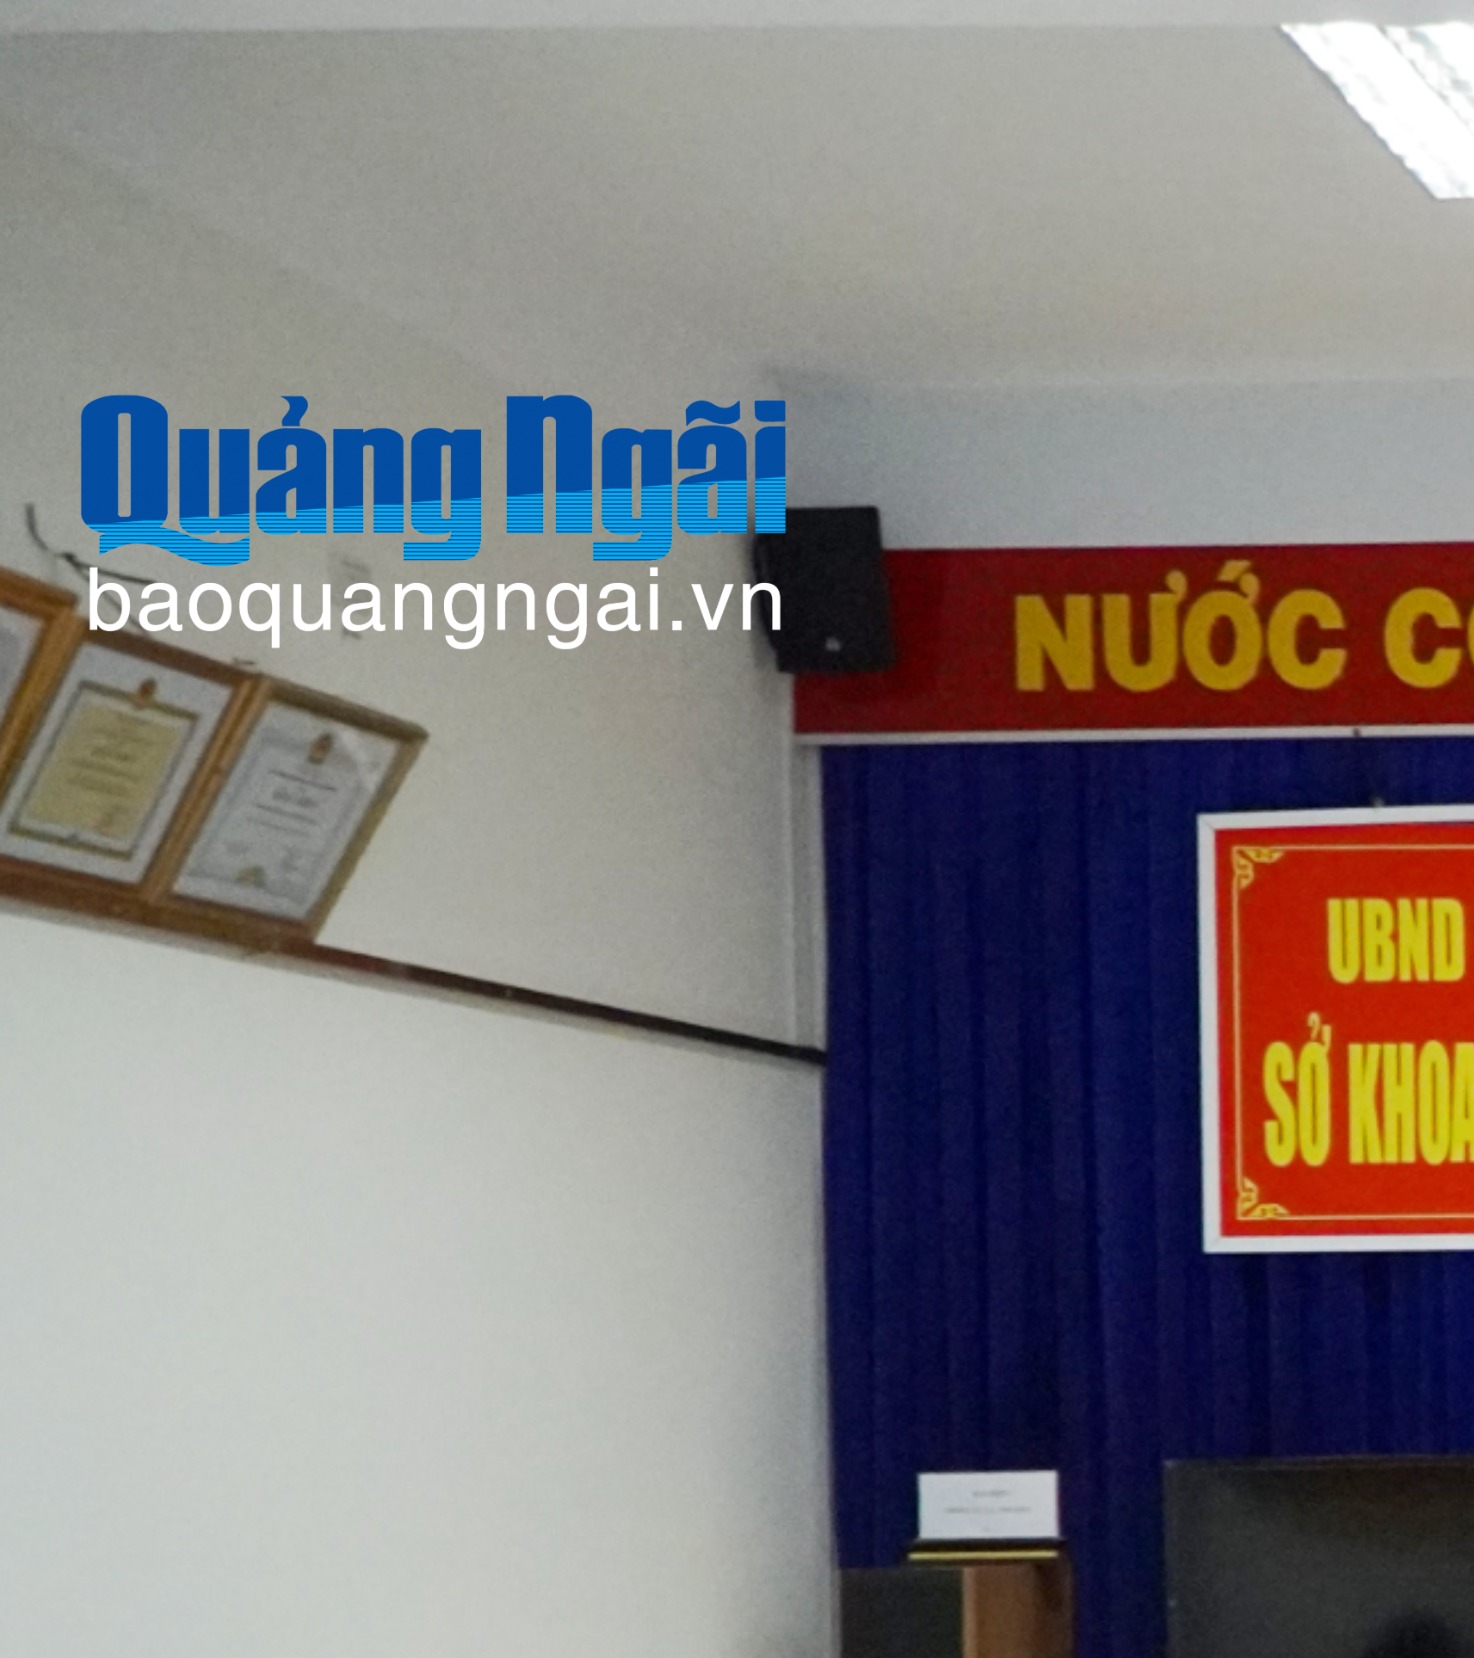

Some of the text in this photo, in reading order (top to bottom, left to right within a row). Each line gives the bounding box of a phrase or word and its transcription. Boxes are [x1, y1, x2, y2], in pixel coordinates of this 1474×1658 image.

[1014, 559, 1347, 692] NƯỚC
[1326, 896, 1466, 984] UBND
[1263, 1011, 1332, 1167] SỞ
